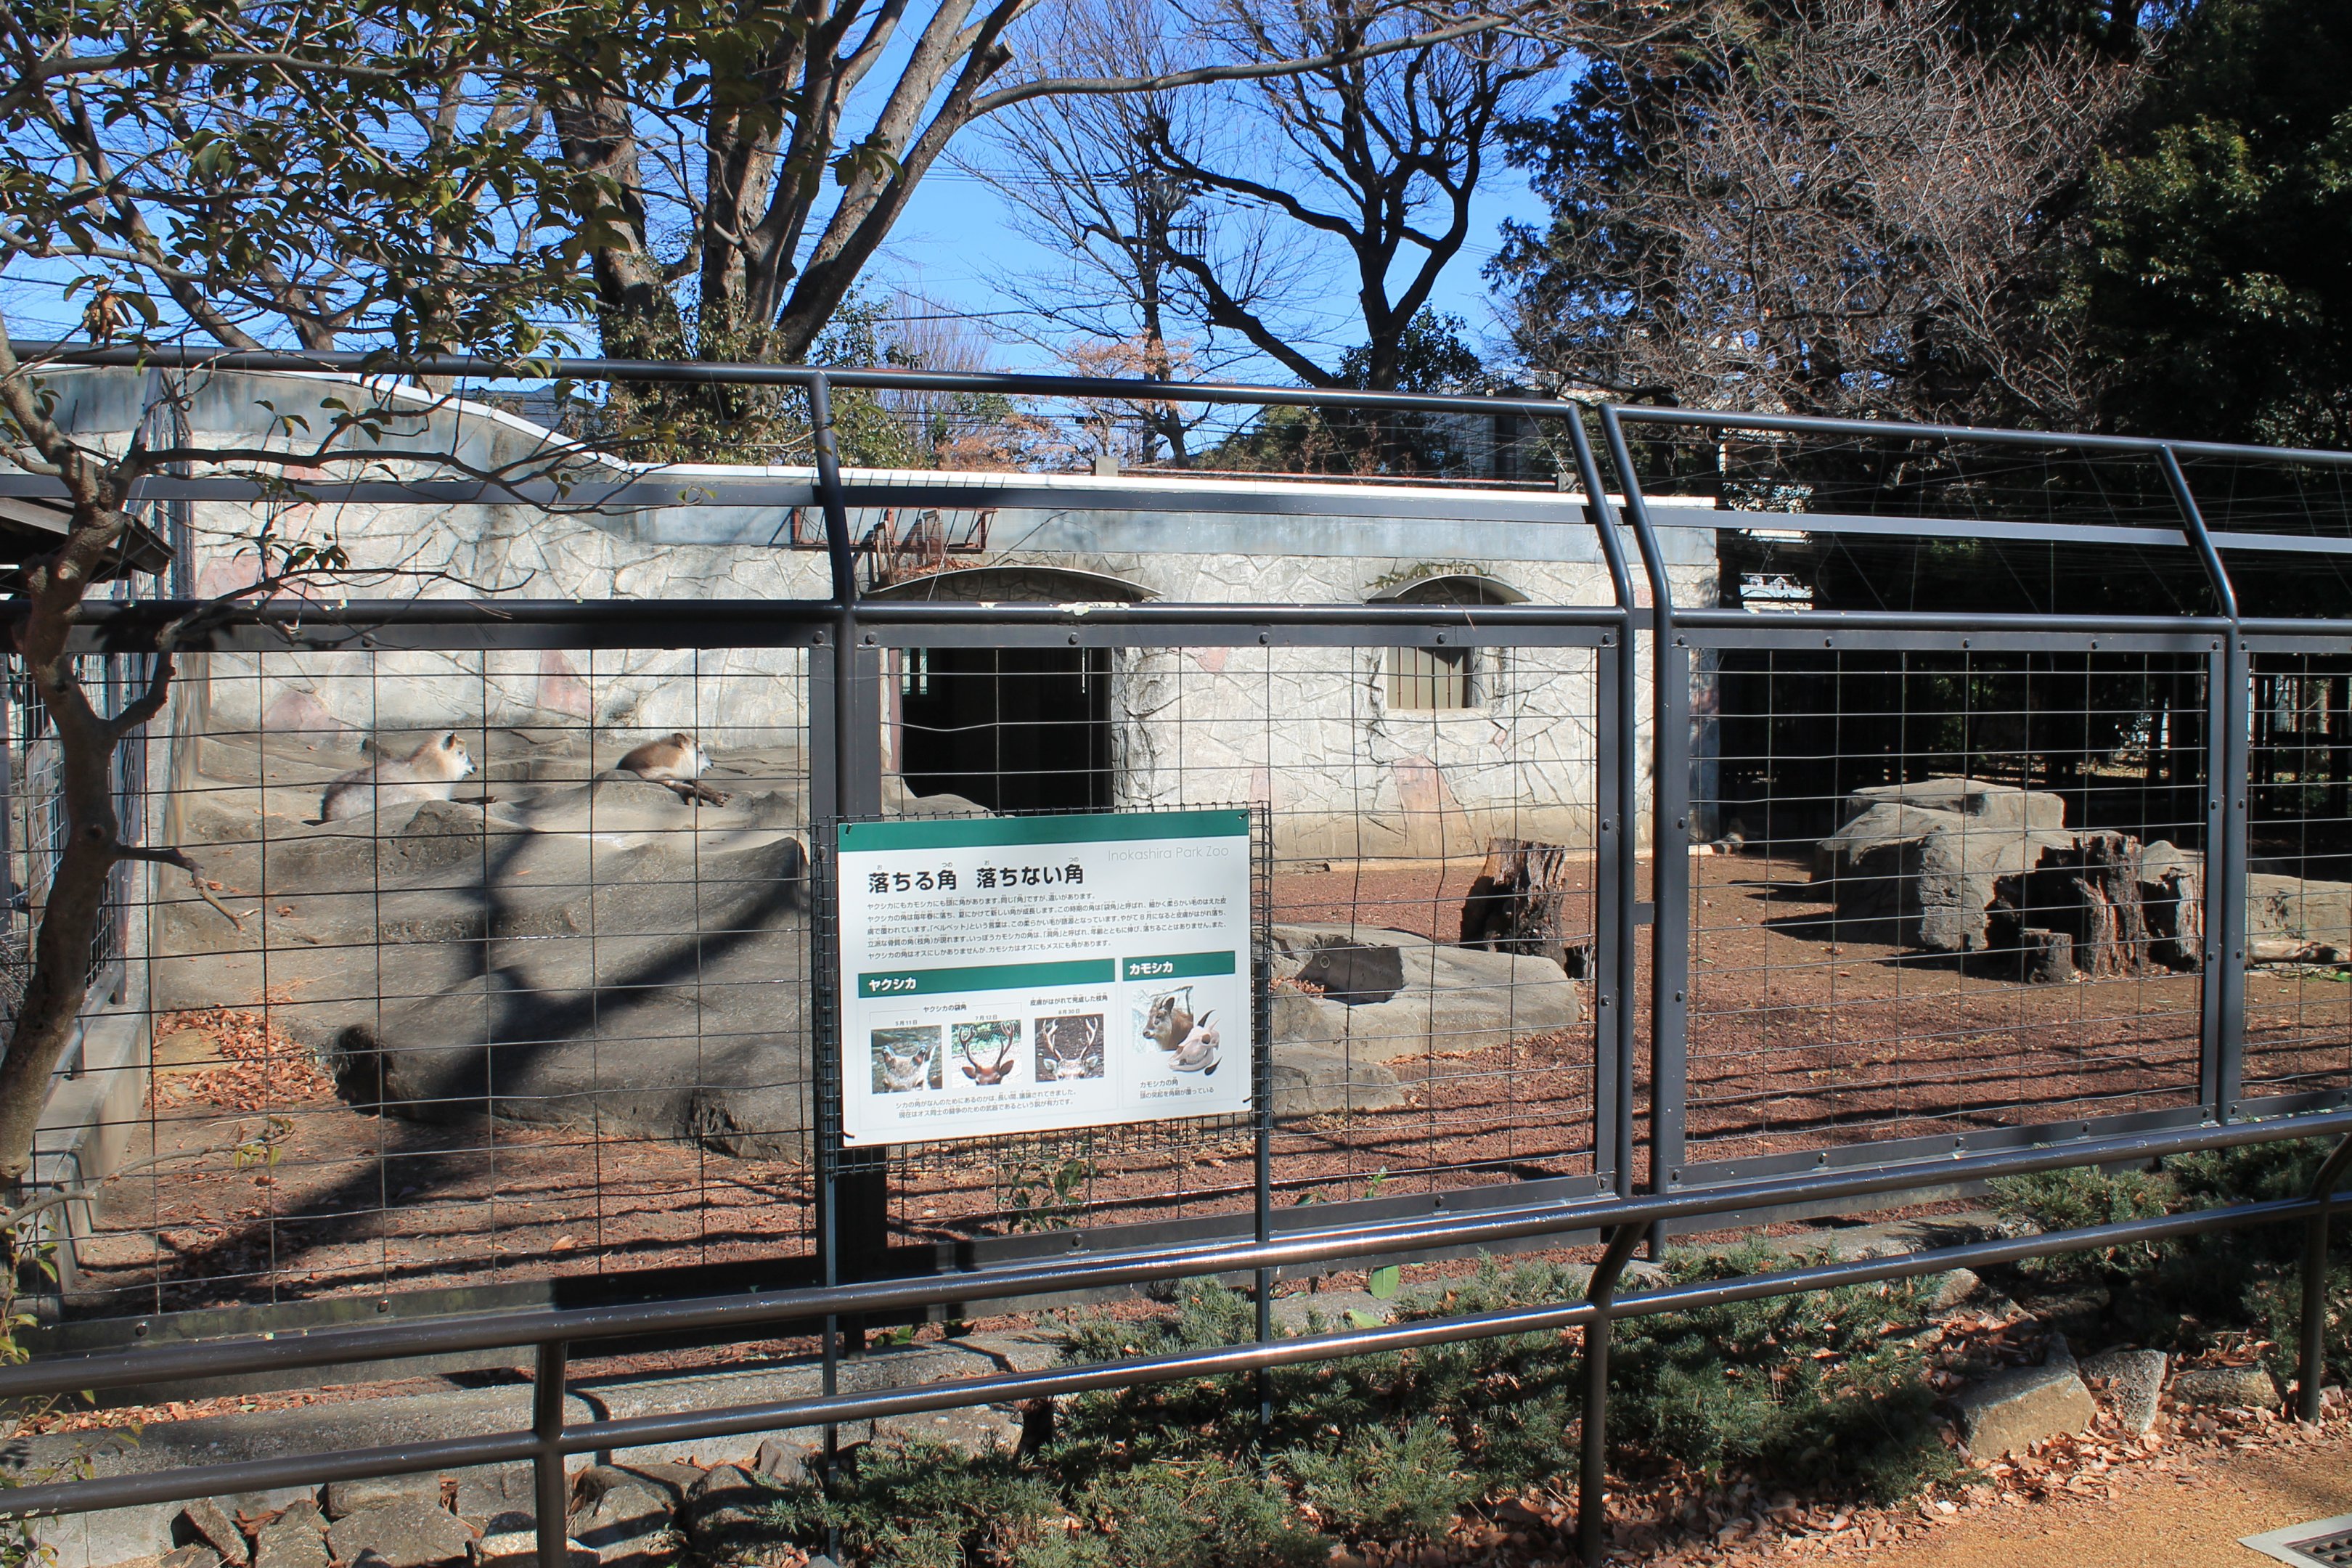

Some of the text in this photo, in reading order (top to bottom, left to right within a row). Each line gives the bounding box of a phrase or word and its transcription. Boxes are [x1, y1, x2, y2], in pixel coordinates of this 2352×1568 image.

[1108, 846, 1229, 862] Inokashira Park Zoo
[868, 864, 1083, 894] 落ちる角 落ちない角
[1129, 960, 1174, 976] カモシカ
[868, 977, 916, 992] ヤクシカ
[923, 1004, 967, 1013] ヤクシカの袋角
[1140, 1079, 1178, 1088] カモシカの角
